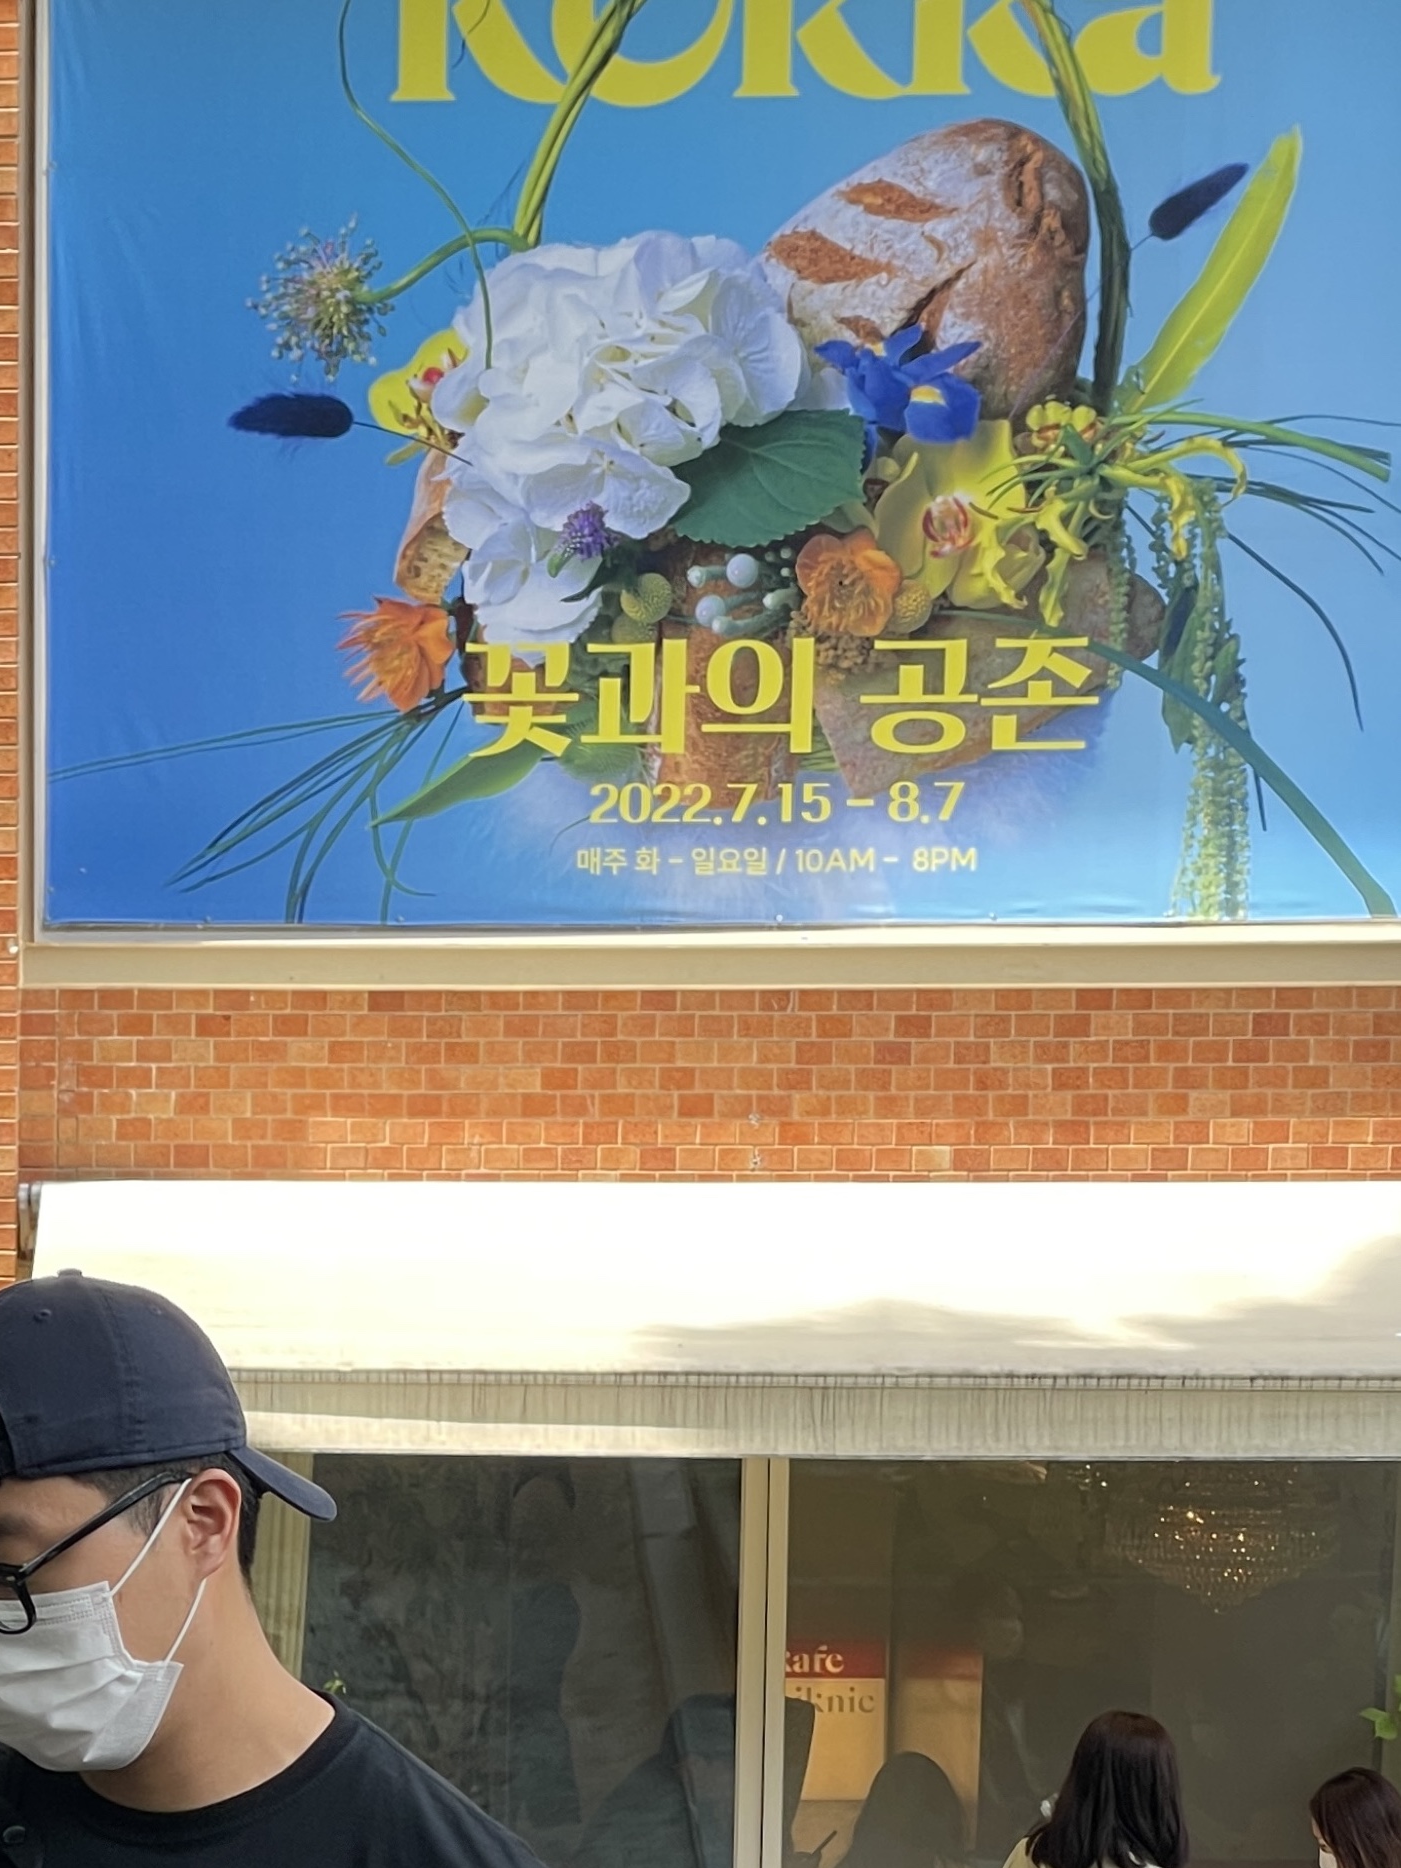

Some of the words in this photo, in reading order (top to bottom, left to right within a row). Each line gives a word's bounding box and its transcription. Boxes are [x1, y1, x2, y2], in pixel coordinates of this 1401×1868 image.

[463, 637, 815, 757] 꽃과의
[860, 636, 1099, 753] 공존
[589, 781, 832, 826] 2022.7.15
[887, 780, 966, 824] 8.7
[577, 847, 627, 875] 매주
[634, 847, 661, 875] 화
[691, 846, 768, 875] 일요일
[795, 847, 875, 873] 10AM
[912, 846, 978, 872] 8PM
